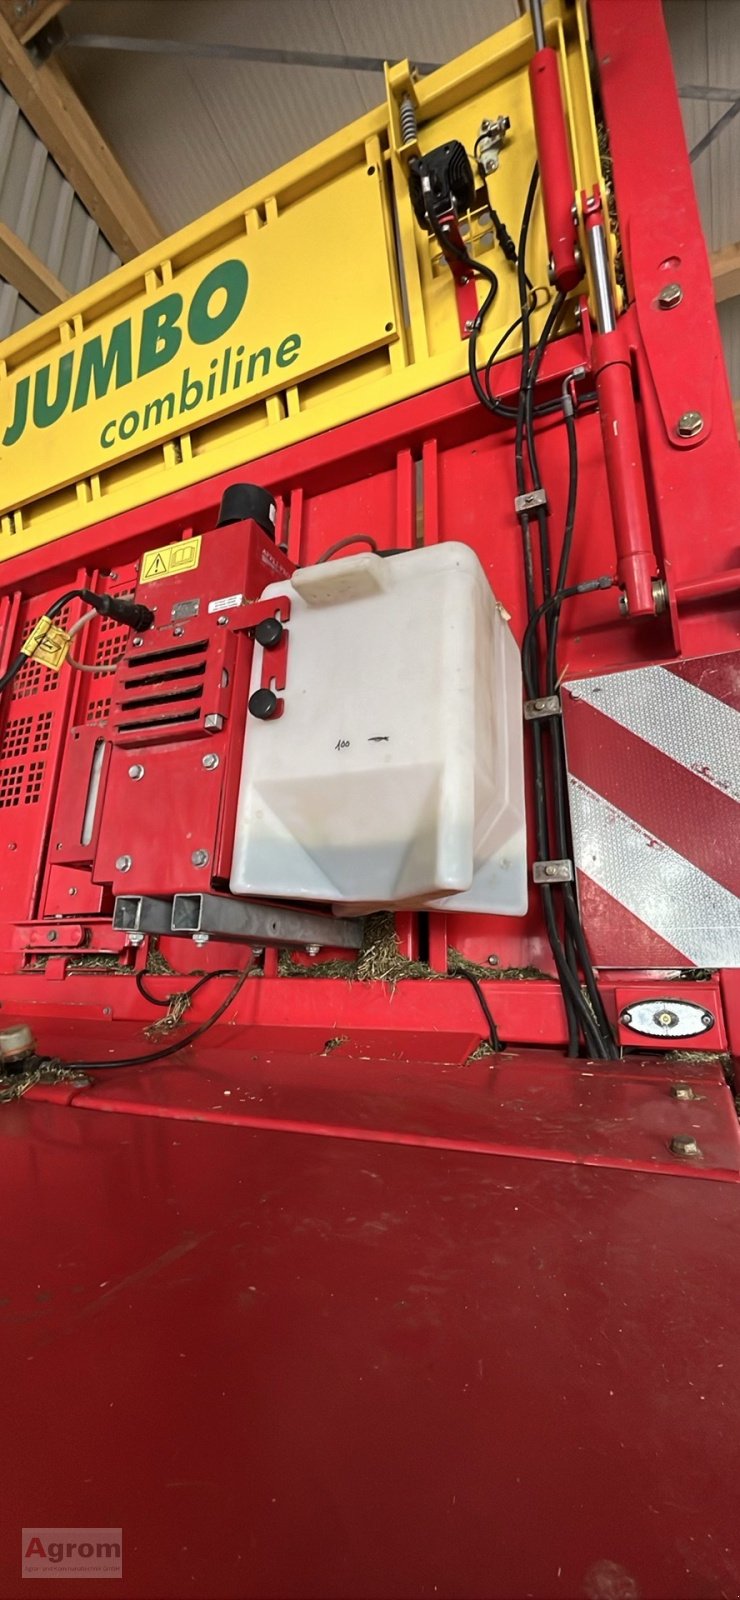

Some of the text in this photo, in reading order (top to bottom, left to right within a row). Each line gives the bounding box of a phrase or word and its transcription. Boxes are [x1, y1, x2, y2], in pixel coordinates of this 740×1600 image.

[2, 259, 250, 447] JUMBO
[100, 333, 302, 449] combiline
[334, 739, 351, 751] 100
